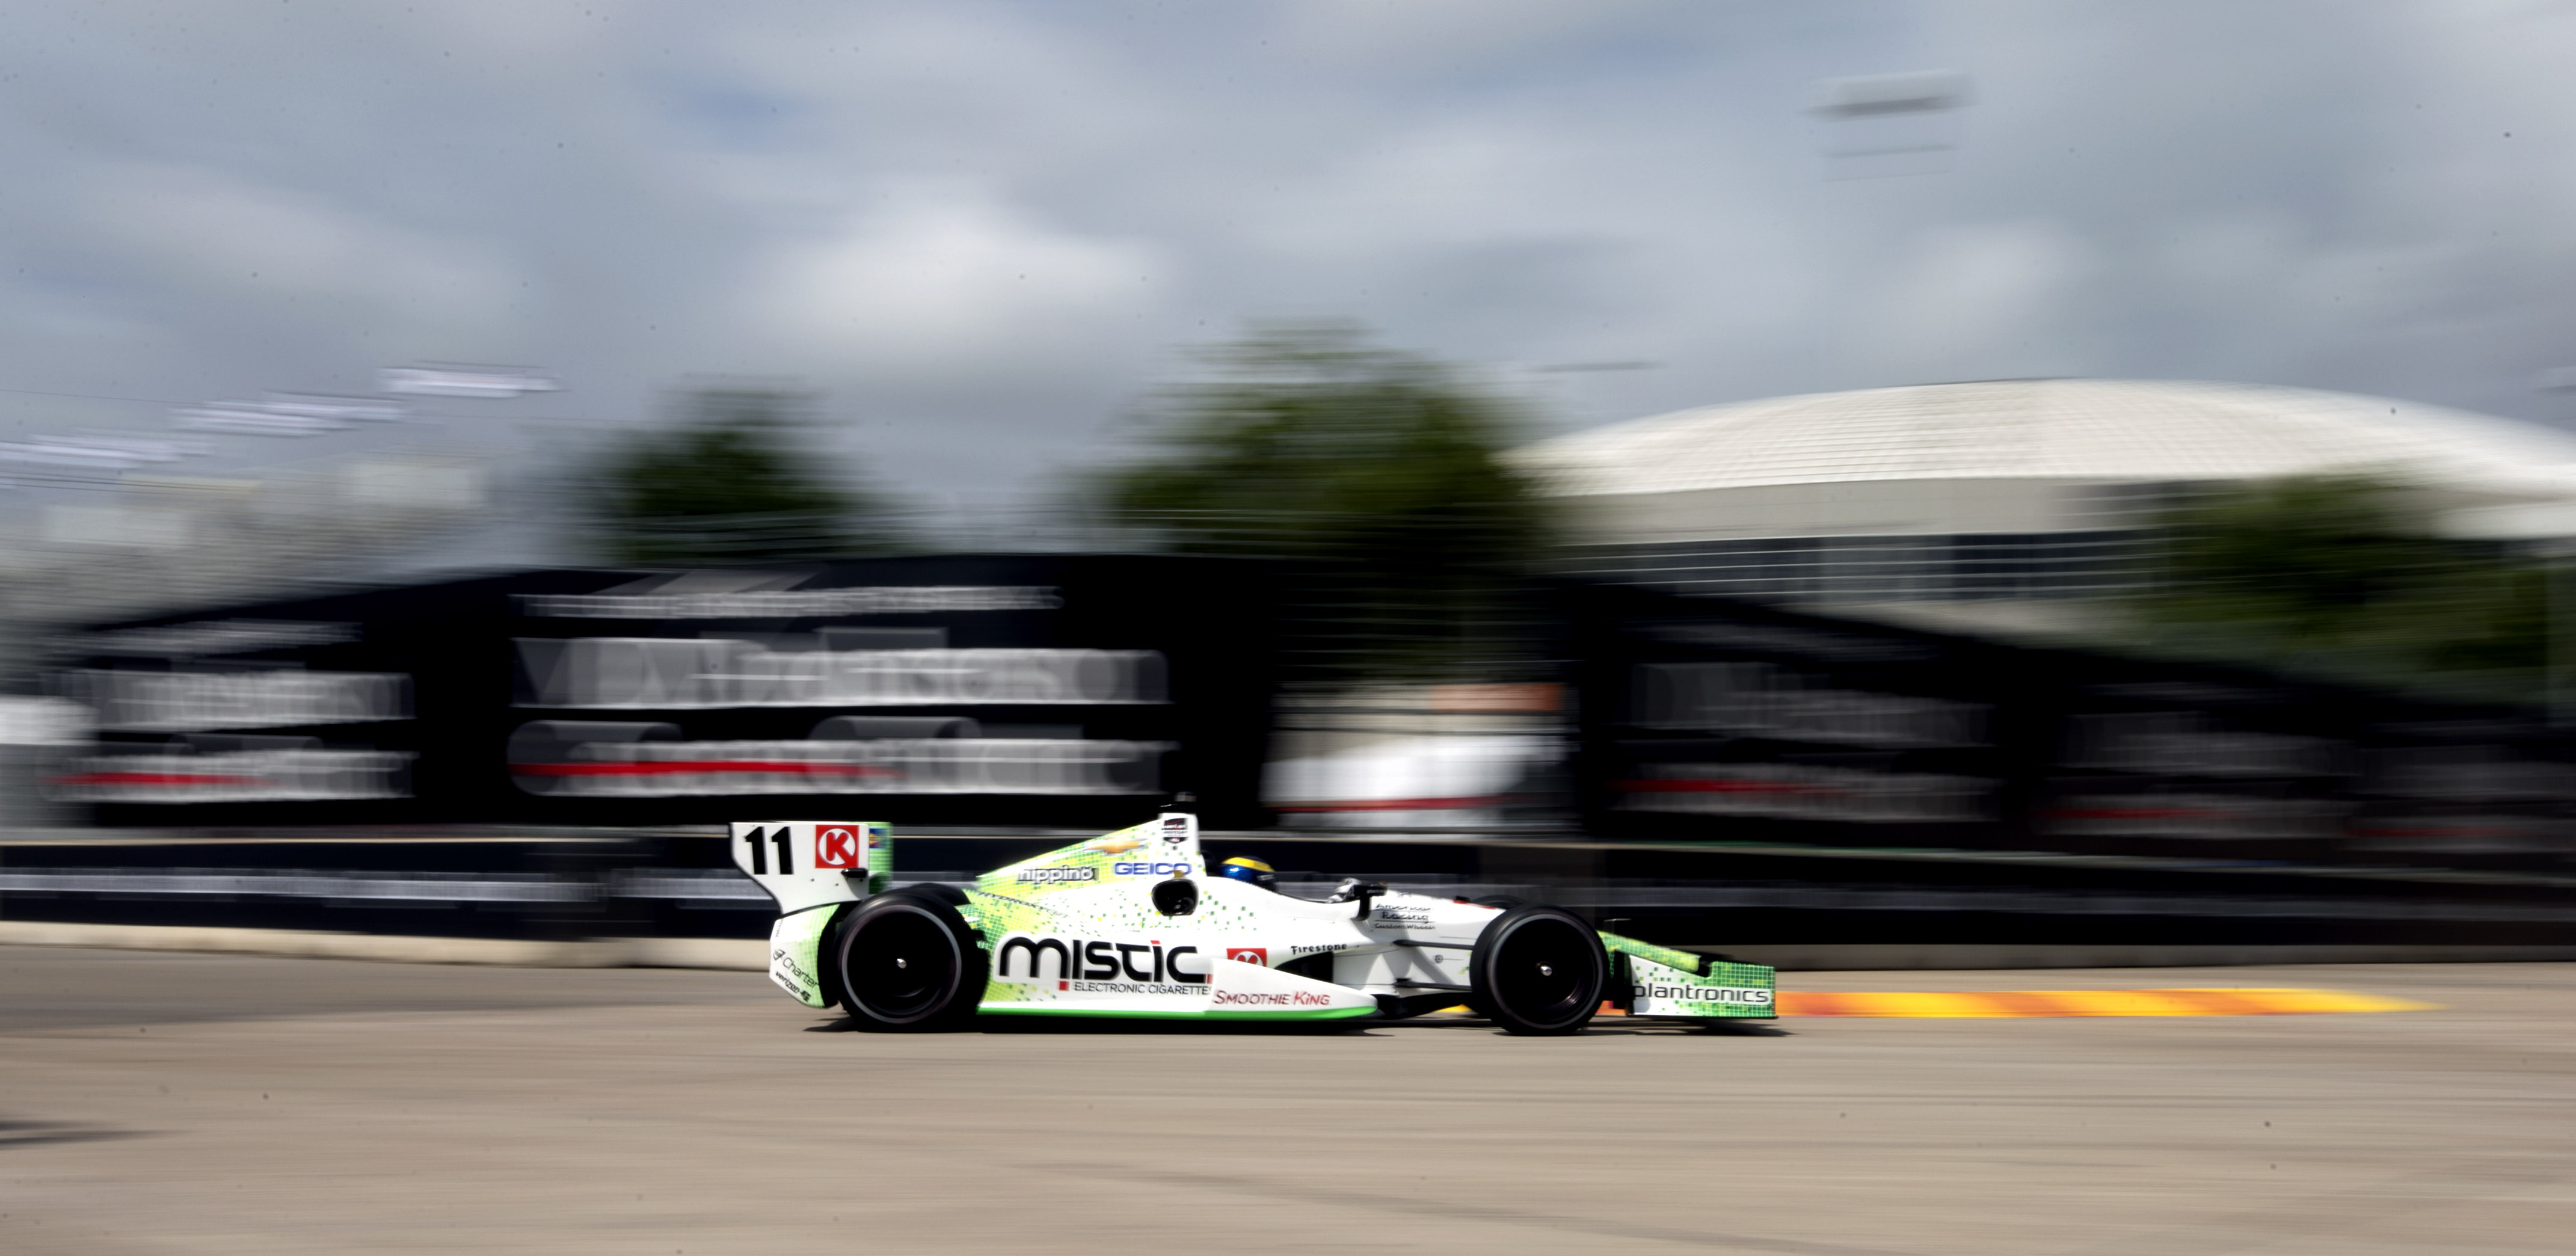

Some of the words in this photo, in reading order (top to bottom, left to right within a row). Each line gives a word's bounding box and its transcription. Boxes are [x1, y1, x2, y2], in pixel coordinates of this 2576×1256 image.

[745, 827, 793, 875] 11
[1114, 863, 1191, 875] GEICO
[1382, 911, 1429, 924] Racing
[1291, 943, 1347, 955] Firestone
[782, 956, 820, 989] Charter
[1074, 982, 1145, 994] ELECTRONIC
